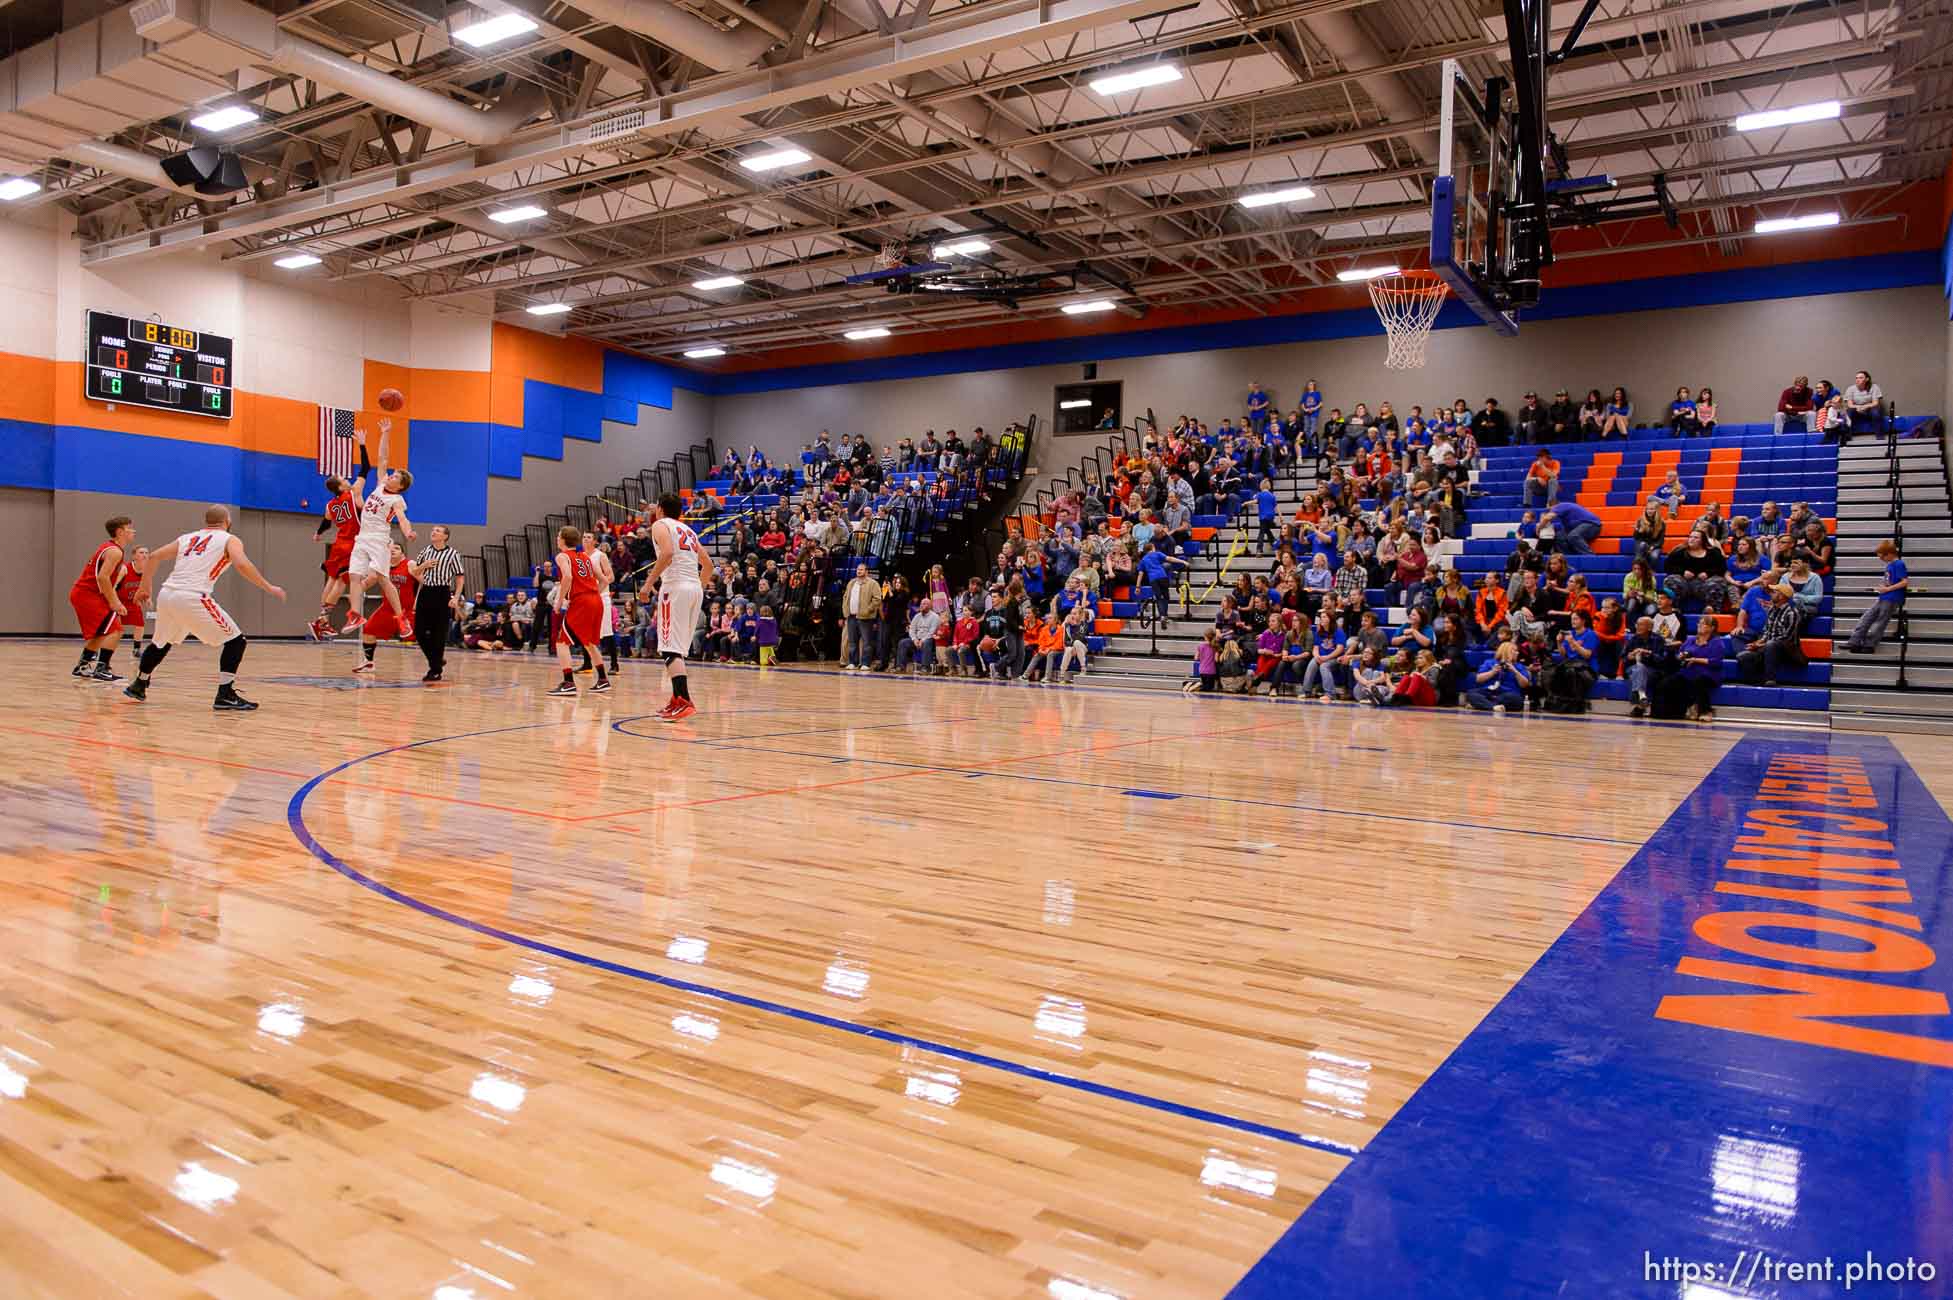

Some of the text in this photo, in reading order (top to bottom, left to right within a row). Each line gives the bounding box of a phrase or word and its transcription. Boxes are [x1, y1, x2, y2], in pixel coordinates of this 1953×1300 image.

[101, 336, 126, 347] HOME
[145, 323, 194, 349] 8:00
[115, 349, 128, 369] 0
[197, 353, 226, 365] VISITOR
[101, 370, 121, 378] FOULS
[145, 363, 167, 372] PERIOD
[139, 376, 163, 385] PLAYER
[212, 368, 224, 384] 0
[111, 379, 122, 394] 0
[211, 395, 221, 409] 0
[332, 501, 352, 523] 21
[184, 535, 213, 556] 14
[1654, 809, 1953, 1068] CANYON
